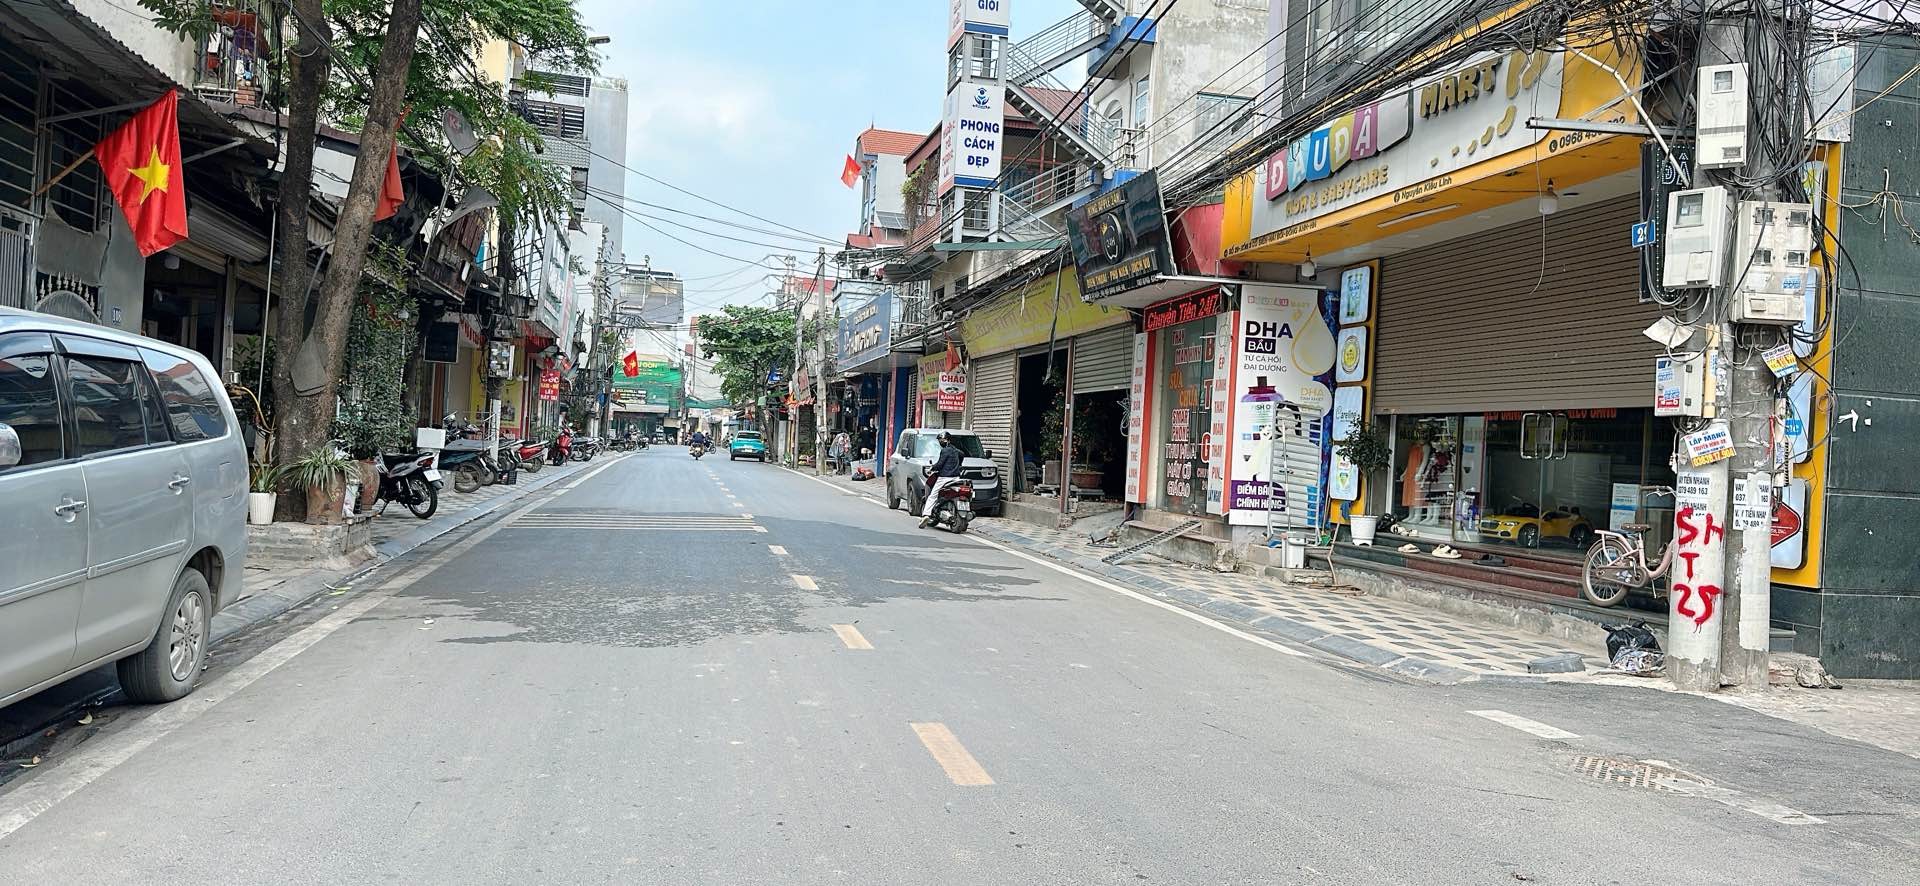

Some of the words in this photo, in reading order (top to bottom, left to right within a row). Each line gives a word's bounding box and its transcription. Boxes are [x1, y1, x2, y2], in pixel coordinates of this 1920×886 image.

[1420, 57, 1502, 118] MART
[960, 119, 1000, 134] PHONG
[964, 135, 995, 150] CÁCH
[1560, 131, 1583, 148] 0968
[967, 155, 989, 169] ĐẸP
[1321, 164, 1389, 207] BABYCARE
[1439, 177, 1453, 188] Linh
[1246, 320, 1293, 339] DHA
[1245, 354, 1254, 362] TỪ
[1256, 354, 1266, 362] CÁ
[1268, 355, 1281, 363] HỒI
[1259, 363, 1287, 372] DƯƠNG
[1683, 474, 1693, 484] TIỀN
[1693, 476, 1710, 485] NHANH
[1237, 482, 1257, 495] ĐIỂM
[1687, 486, 1697, 494] 489
[1698, 487, 1708, 495] 163
[1236, 497, 1260, 508] CHÍNH
[1746, 507, 1755, 518] TIỀN
[1679, 552, 1700, 580] T
[1673, 583, 1721, 625] 25
